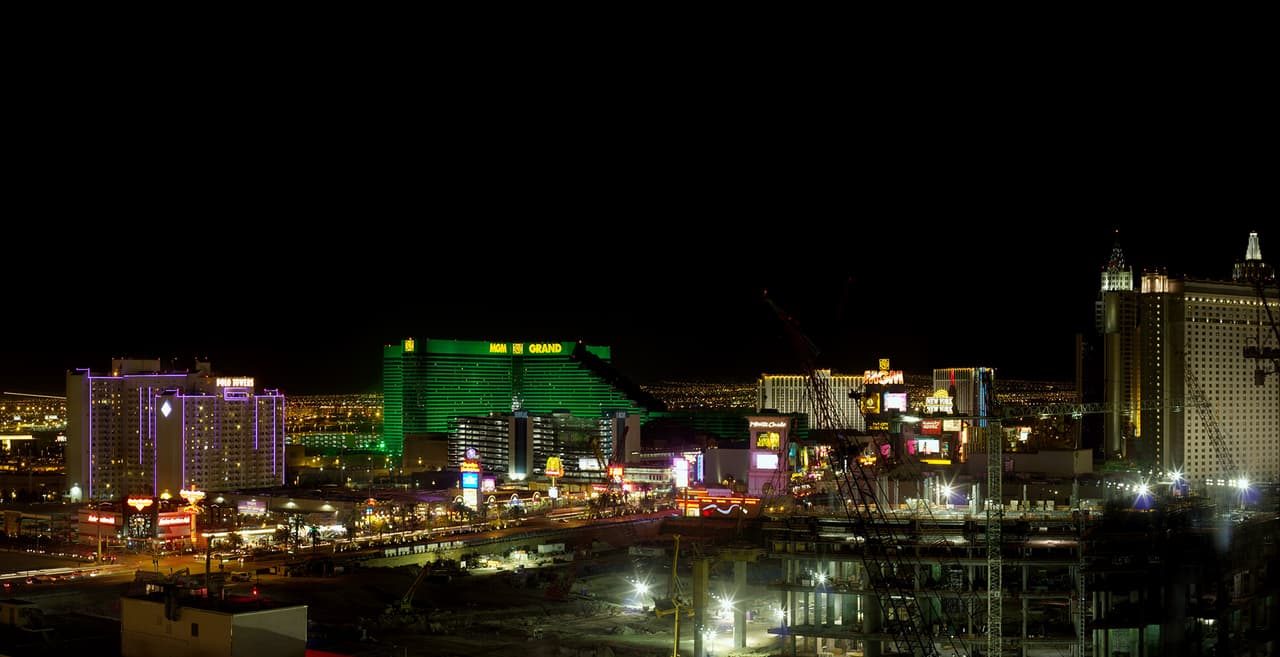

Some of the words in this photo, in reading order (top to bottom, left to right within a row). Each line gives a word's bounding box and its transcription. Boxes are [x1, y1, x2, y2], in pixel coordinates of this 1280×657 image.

[489, 342, 507, 353] MGM
[528, 343, 562, 354] GRAND
[863, 370, 904, 385] MGM
